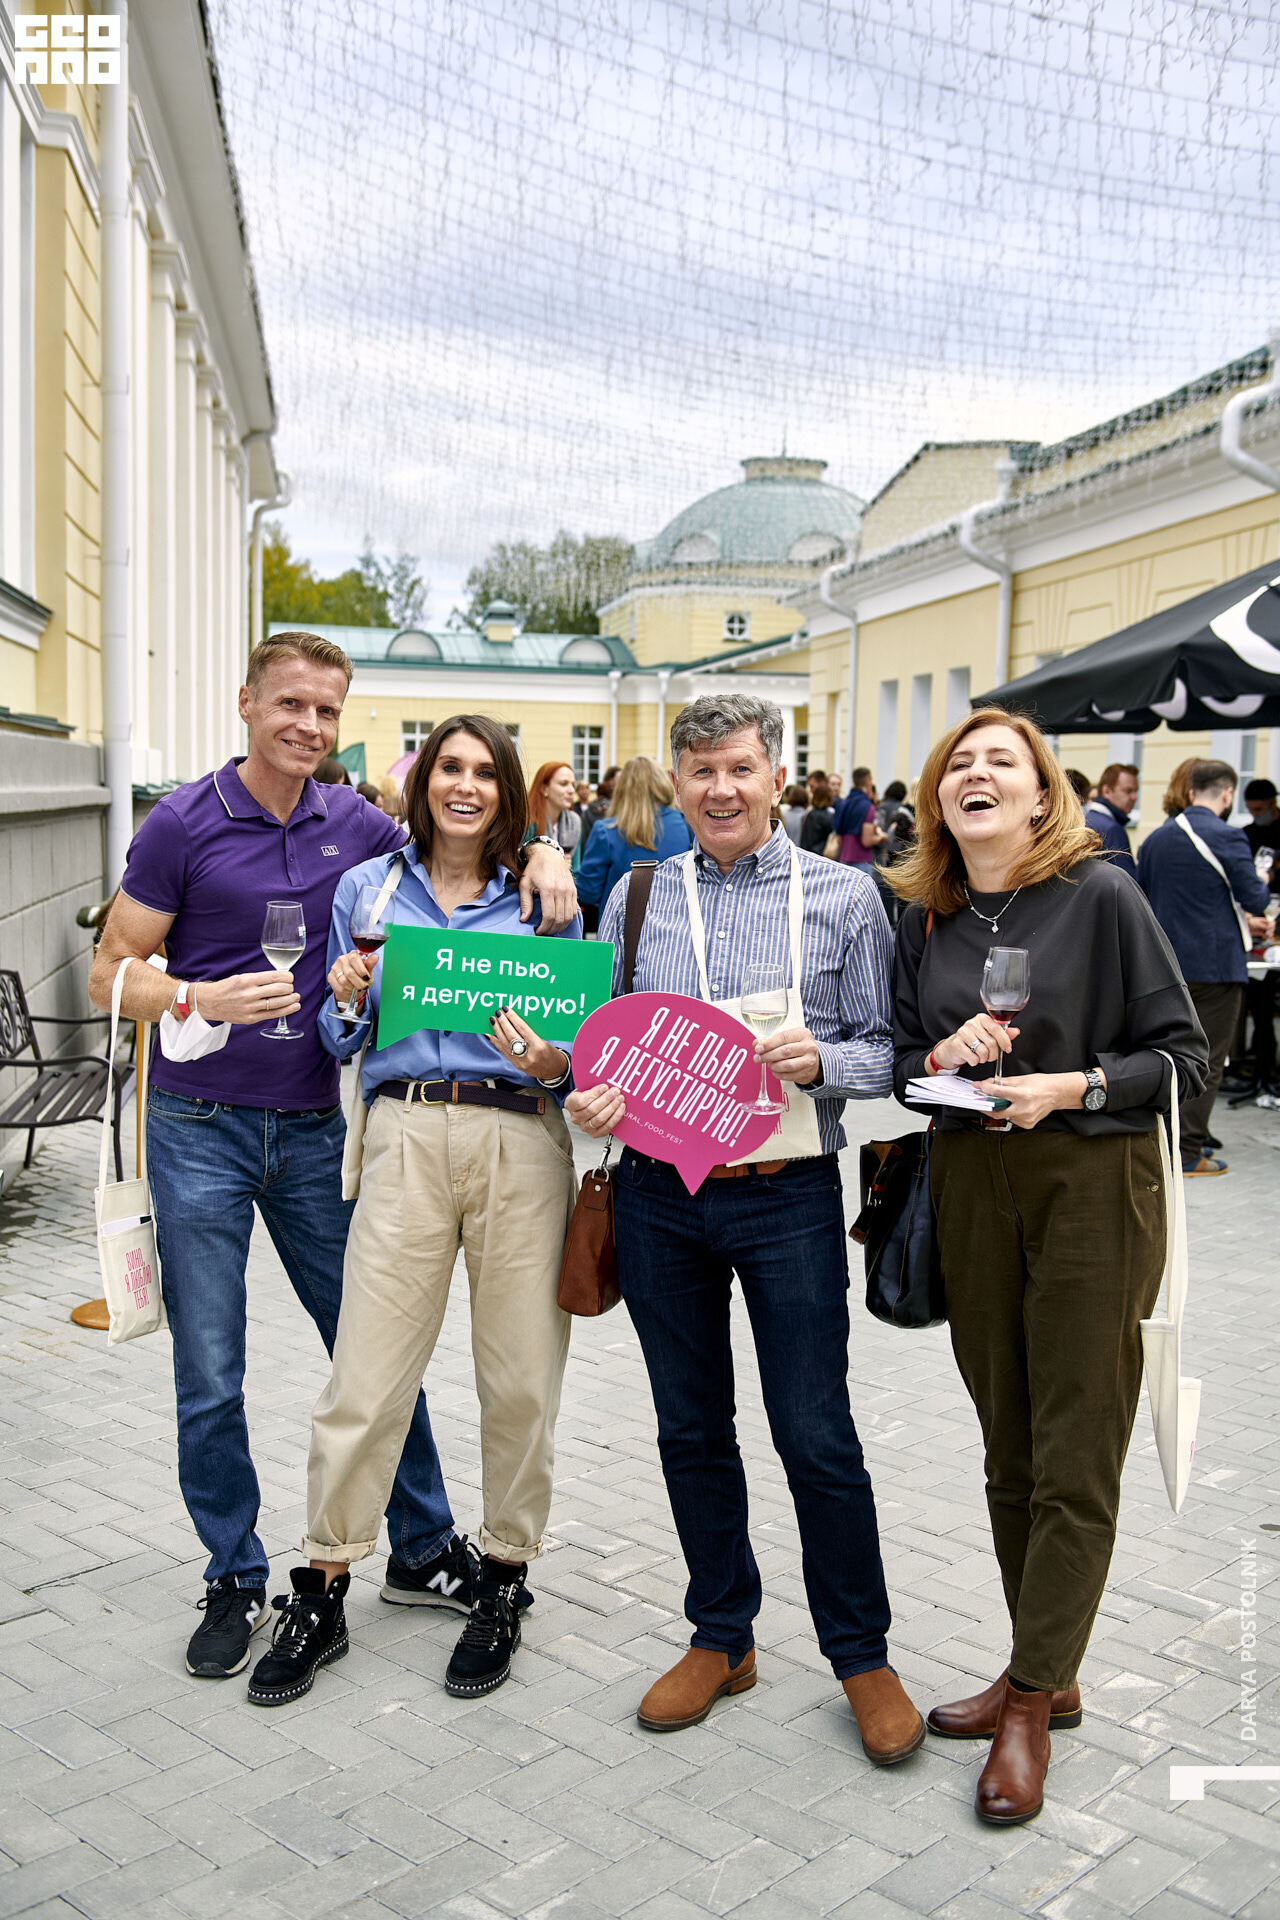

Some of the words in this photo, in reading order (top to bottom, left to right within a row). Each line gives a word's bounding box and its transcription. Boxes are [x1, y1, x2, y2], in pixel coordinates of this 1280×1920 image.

[435, 948, 453, 971] Я
[461, 956, 492, 974] не
[499, 959, 556, 984] пью,
[402, 985, 416, 1001] я
[421, 986, 586, 1019] дегустирую!
[638, 1006, 670, 1049] Я
[657, 1015, 700, 1065] НЕ
[687, 1030, 748, 1095] ПЬЮ,
[589, 1036, 621, 1077] Я
[606, 1045, 753, 1148] ДЕГУСТИРУЮ!
[426, 1570, 464, 1597] N
